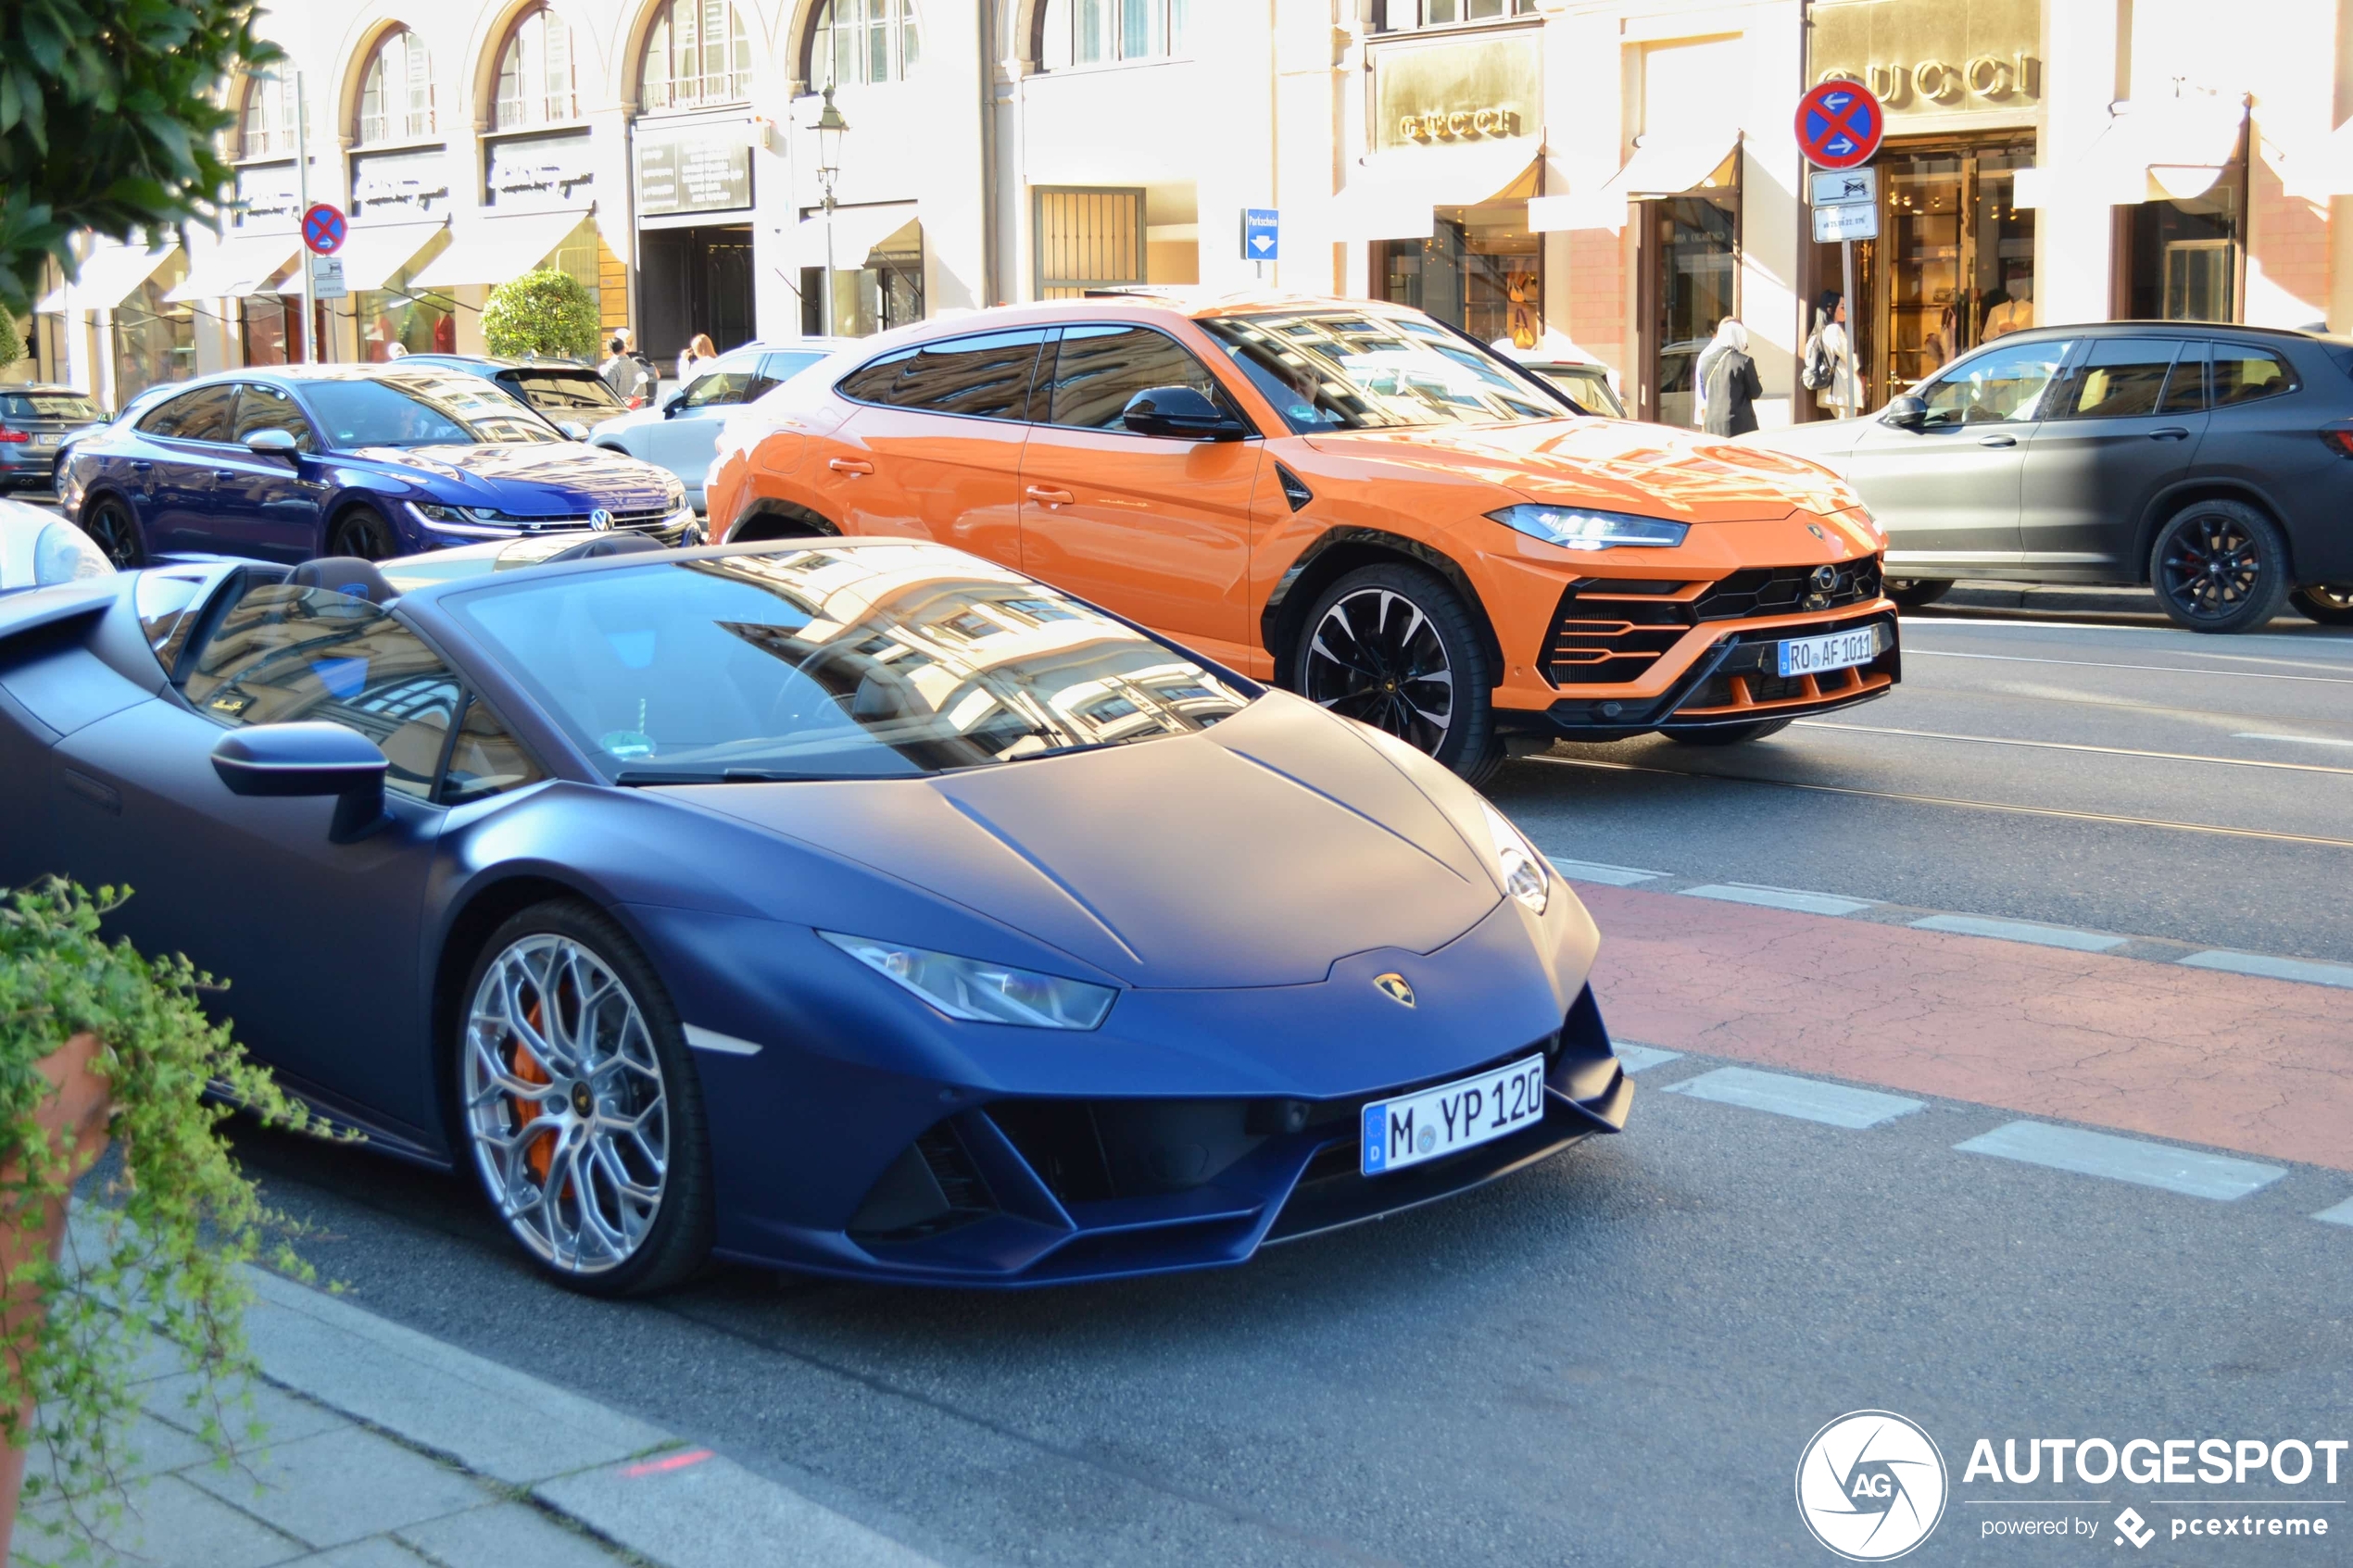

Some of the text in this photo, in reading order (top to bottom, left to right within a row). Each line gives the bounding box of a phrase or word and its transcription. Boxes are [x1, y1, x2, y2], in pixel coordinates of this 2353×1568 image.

[1818, 53, 2028, 104] UCCI
[1400, 109, 1509, 138] GUCCI
[1249, 215, 1277, 227] Parkschein
[1791, 643, 1810, 671] RO
[1822, 639, 1839, 667] AF
[1842, 633, 1870, 663] 1011
[1370, 1066, 1541, 1162] D M YP 120
